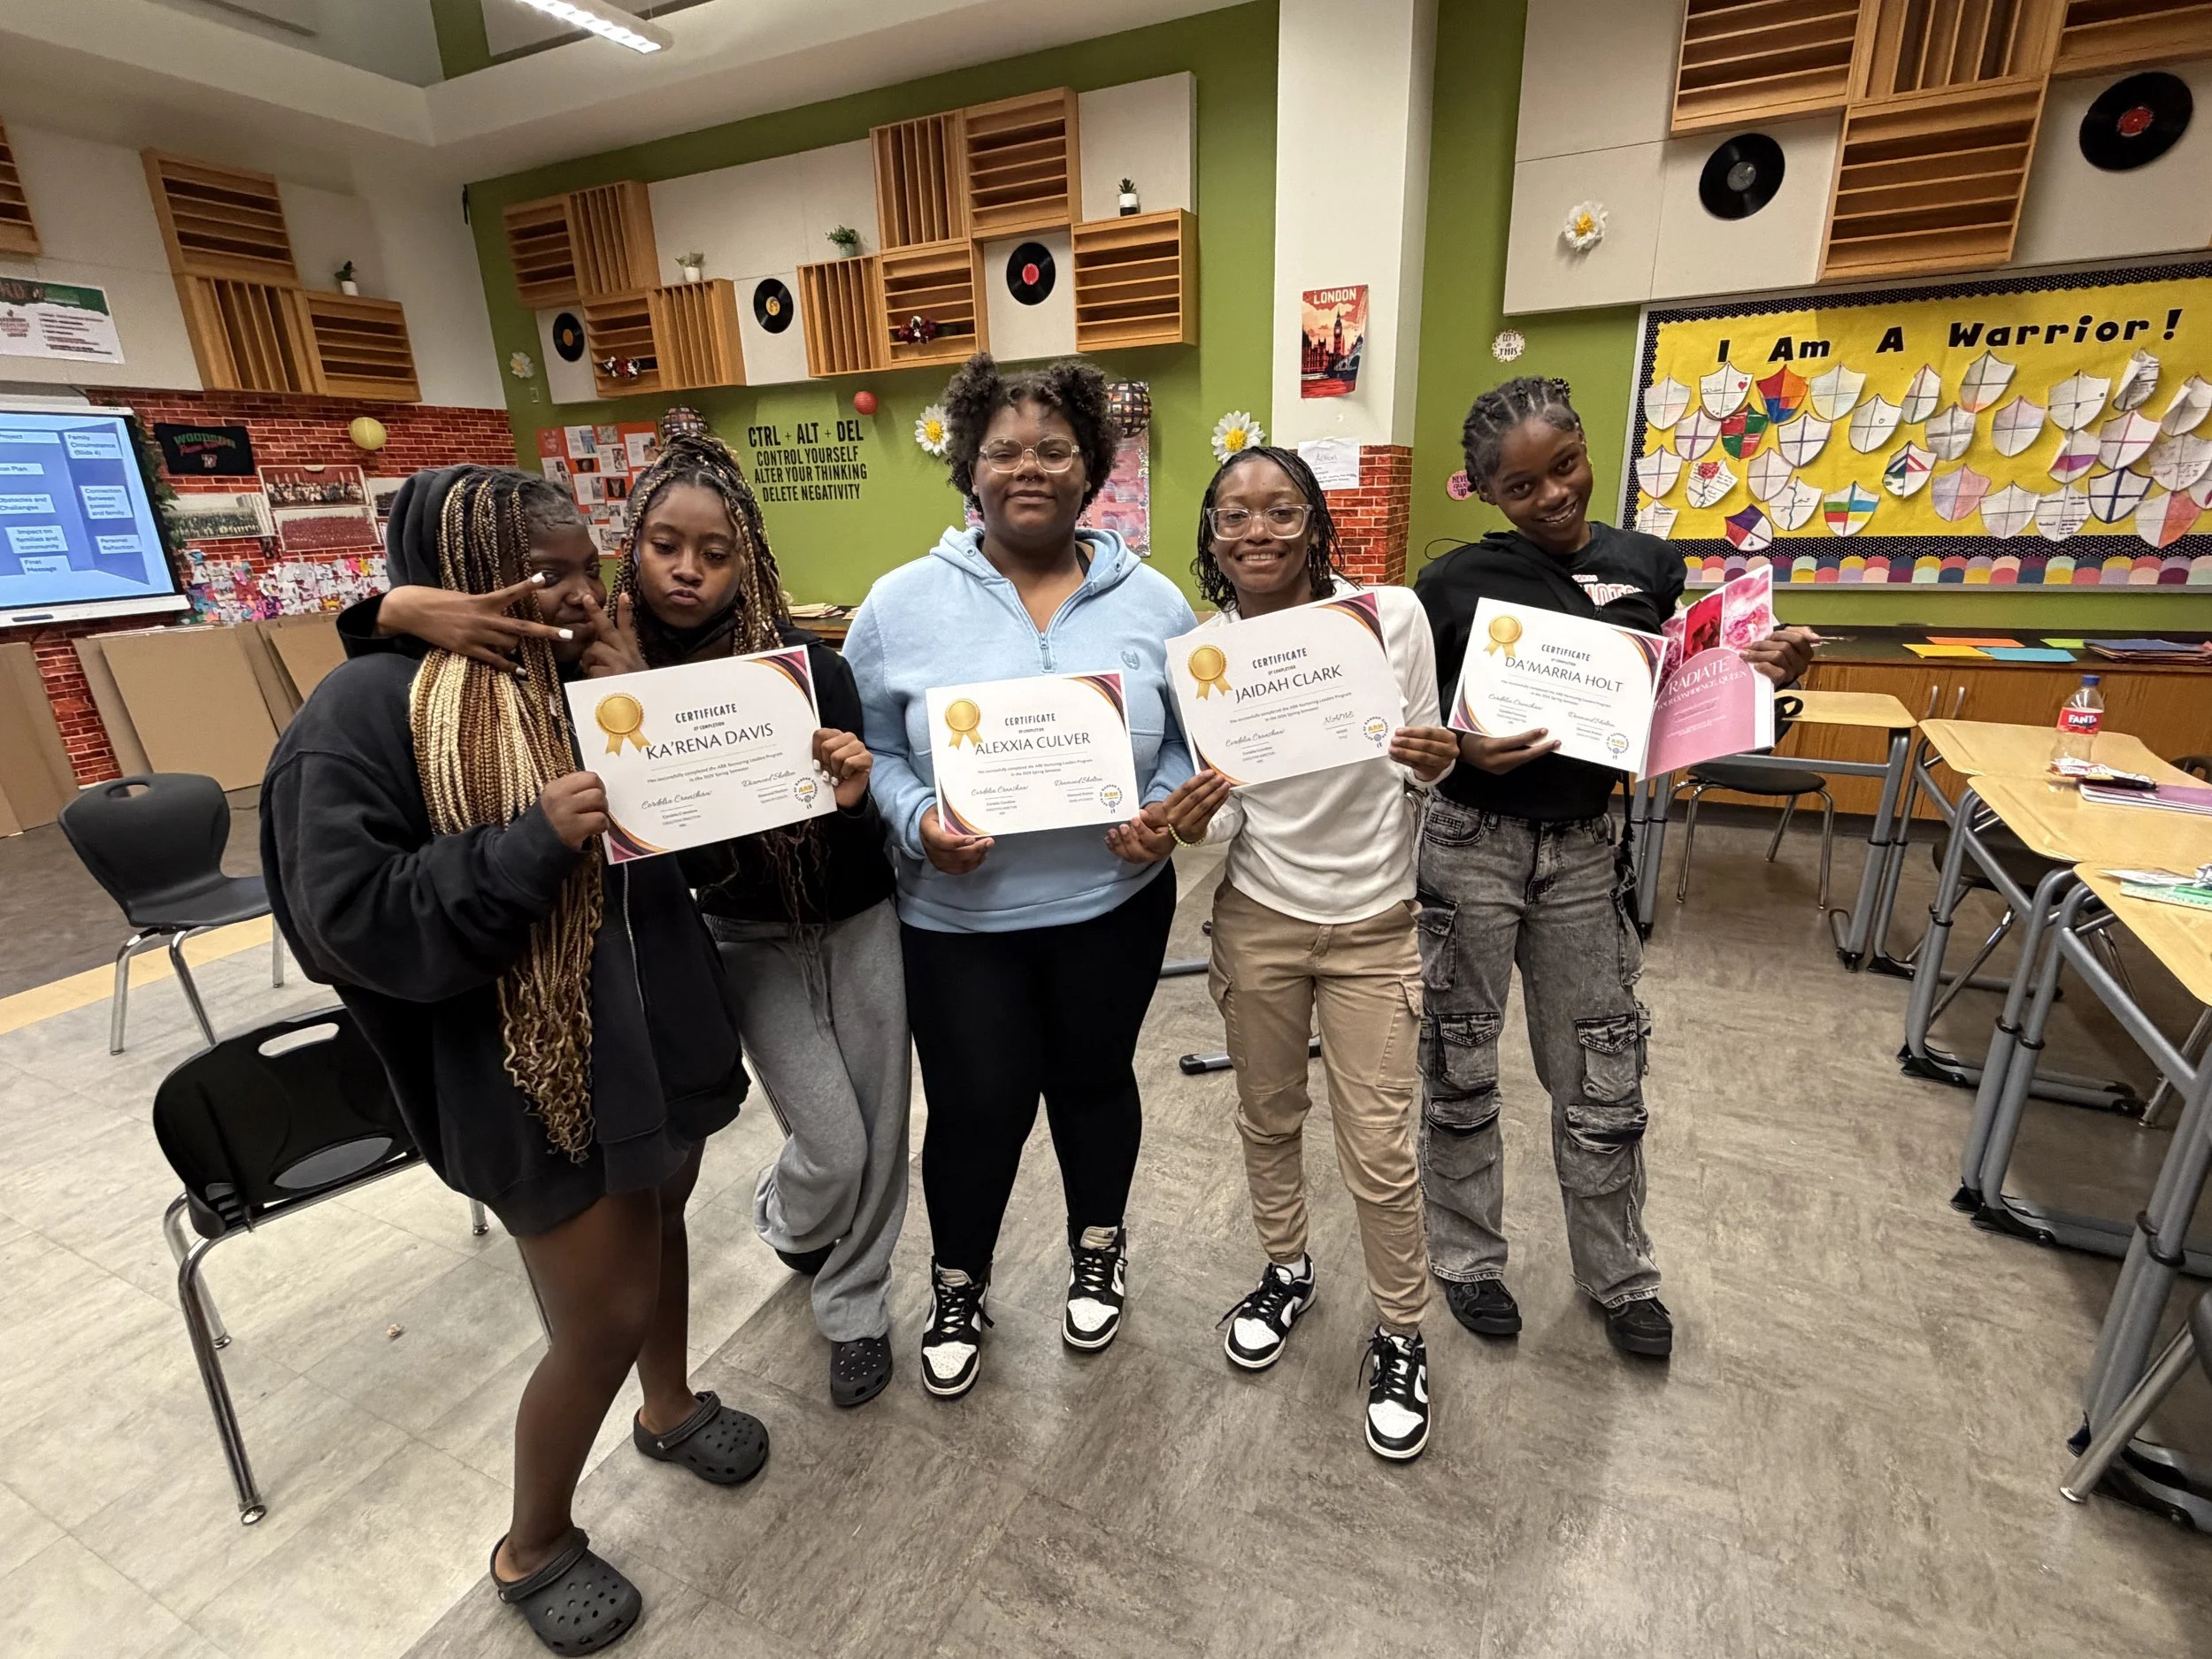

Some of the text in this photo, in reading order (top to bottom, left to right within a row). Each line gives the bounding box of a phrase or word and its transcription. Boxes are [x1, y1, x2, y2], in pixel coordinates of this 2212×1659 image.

[1313, 288, 1356, 305] LONDON
[1499, 347, 1517, 356] THIS
[1717, 340, 1731, 363] I
[1768, 336, 1831, 363] Am
[1876, 326, 1904, 354] A
[749, 425, 781, 448] CTRL
[797, 422, 819, 444] ALT
[837, 419, 864, 442] DEL
[757, 446, 858, 467] CONTROL YOURSELF
[754, 464, 868, 484] ALTER YOUR THINKING
[1453, 474, 1467, 483] NEVE
[763, 483, 860, 503] DELETE NEGATIVITY
[1252, 648, 1309, 670] CERTIFICATE
[1541, 644, 1591, 662] CERTIFICATE
[1235, 664, 1343, 703] JAIDAH CLARK
[1505, 657, 1624, 693] DA'MARRIA HOLT
[1669, 656, 1731, 695] RADIATE
[1718, 671, 1747, 684] QUEEN
[675, 703, 738, 724] CERTIFICATE
[1004, 713, 1056, 726] CERTIFICATE
[646, 723, 774, 760] KA'RENA DAVIS
[975, 732, 1091, 756] ALEXXIA CULVER
